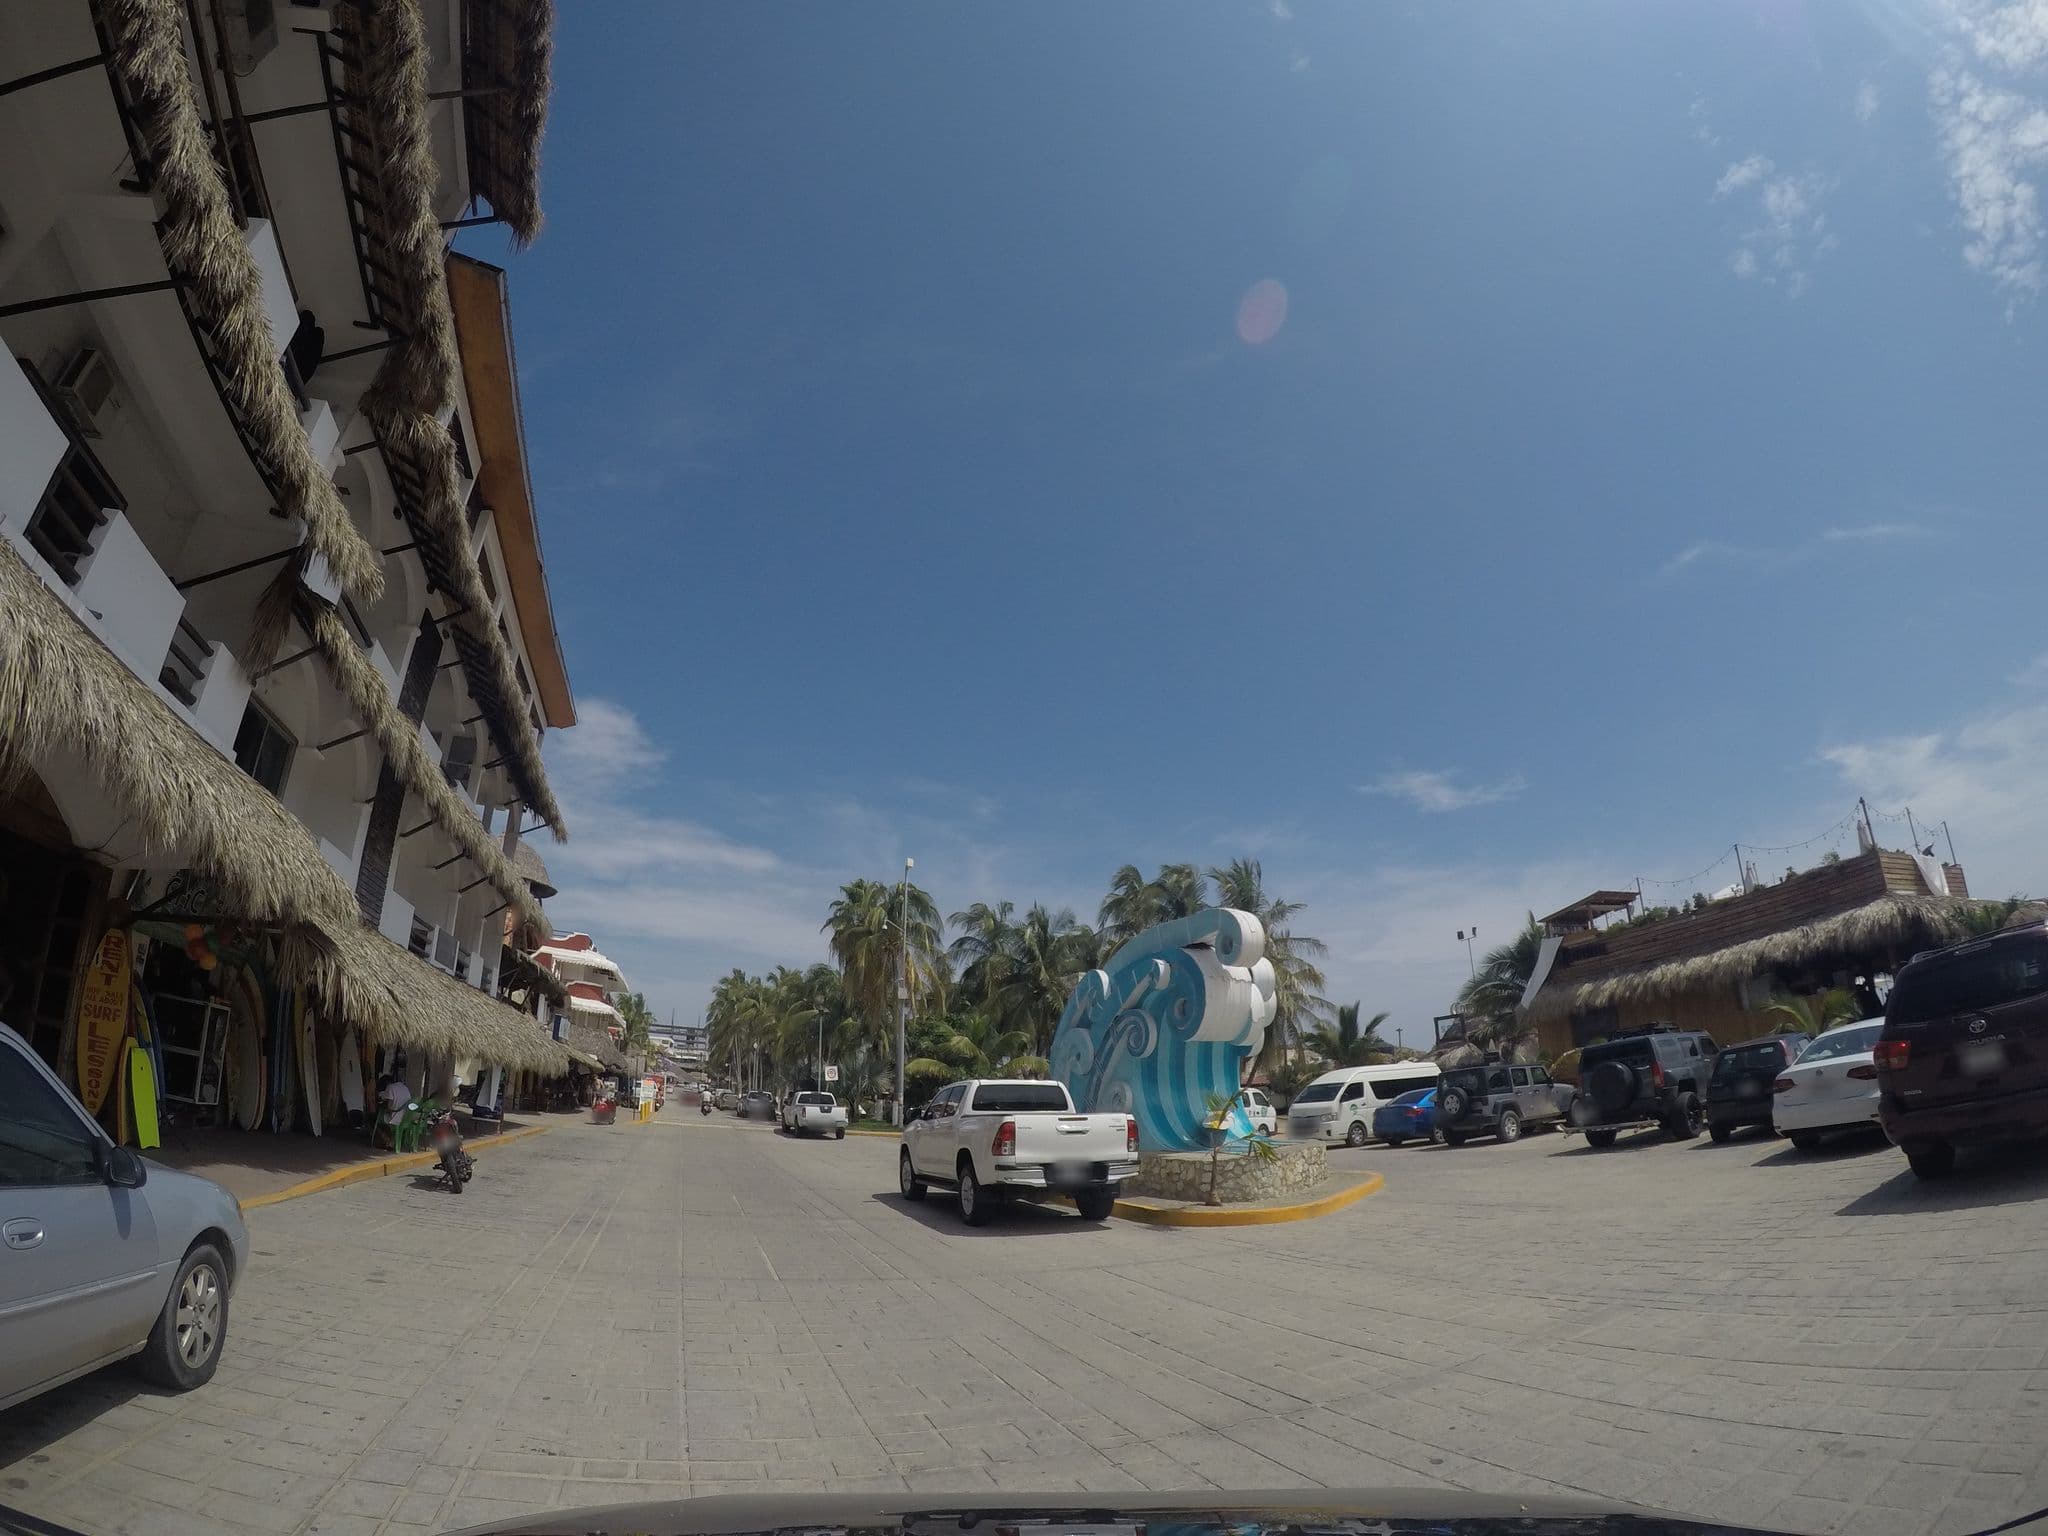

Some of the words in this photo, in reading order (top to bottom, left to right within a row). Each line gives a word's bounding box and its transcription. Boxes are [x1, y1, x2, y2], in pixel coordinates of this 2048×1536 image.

[101, 935, 125, 986] RENT
[84, 1003, 121, 1022] SURF
[88, 1022, 111, 1109] LESSONS
